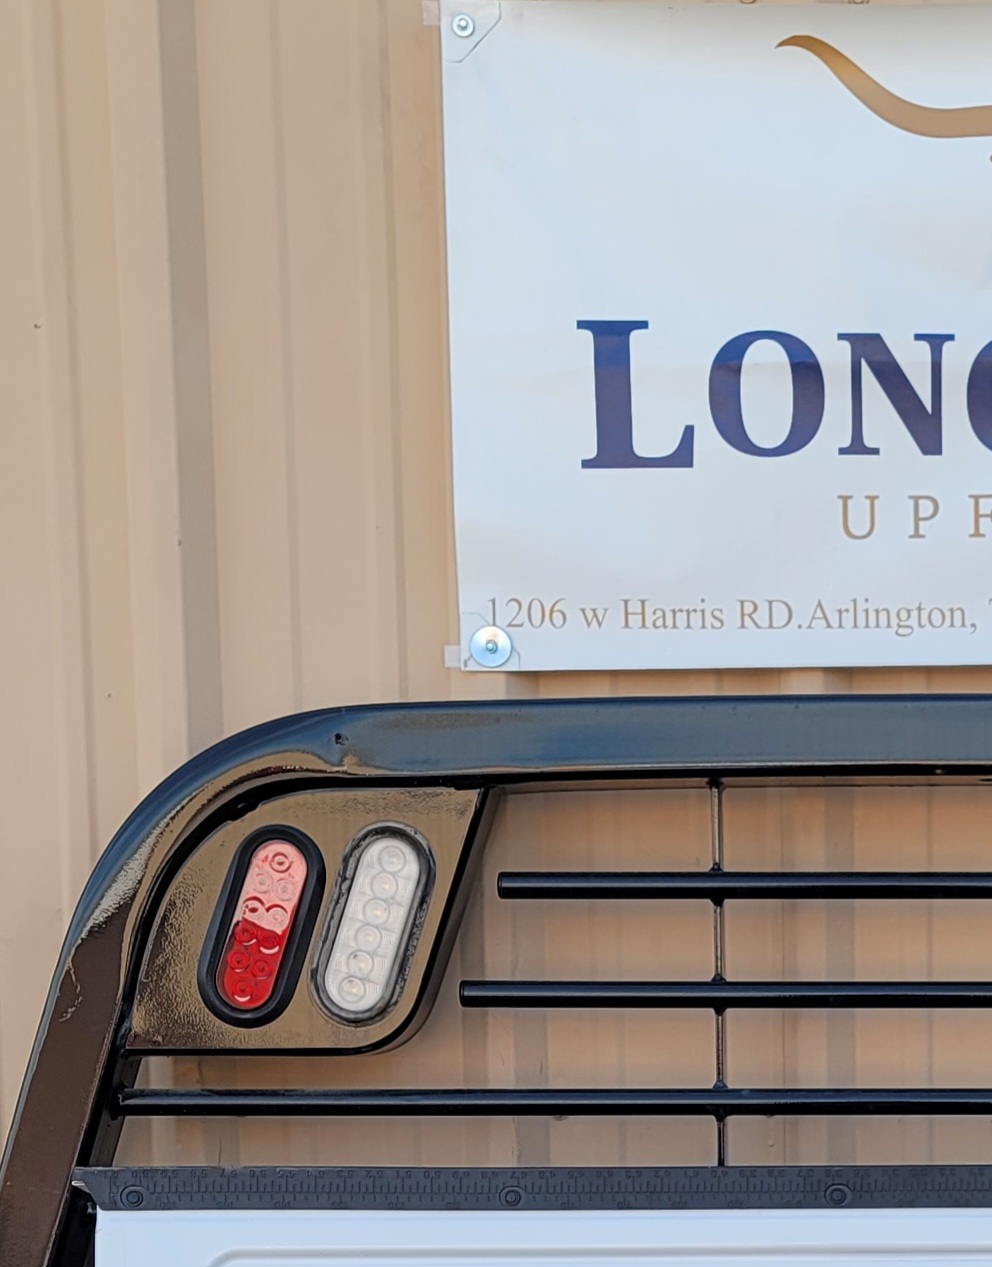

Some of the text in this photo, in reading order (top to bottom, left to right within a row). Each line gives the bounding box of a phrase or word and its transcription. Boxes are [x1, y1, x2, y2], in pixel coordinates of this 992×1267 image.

[488, 597, 568, 629] 1206
[579, 607, 609, 629] w
[620, 597, 725, 630] Harris
